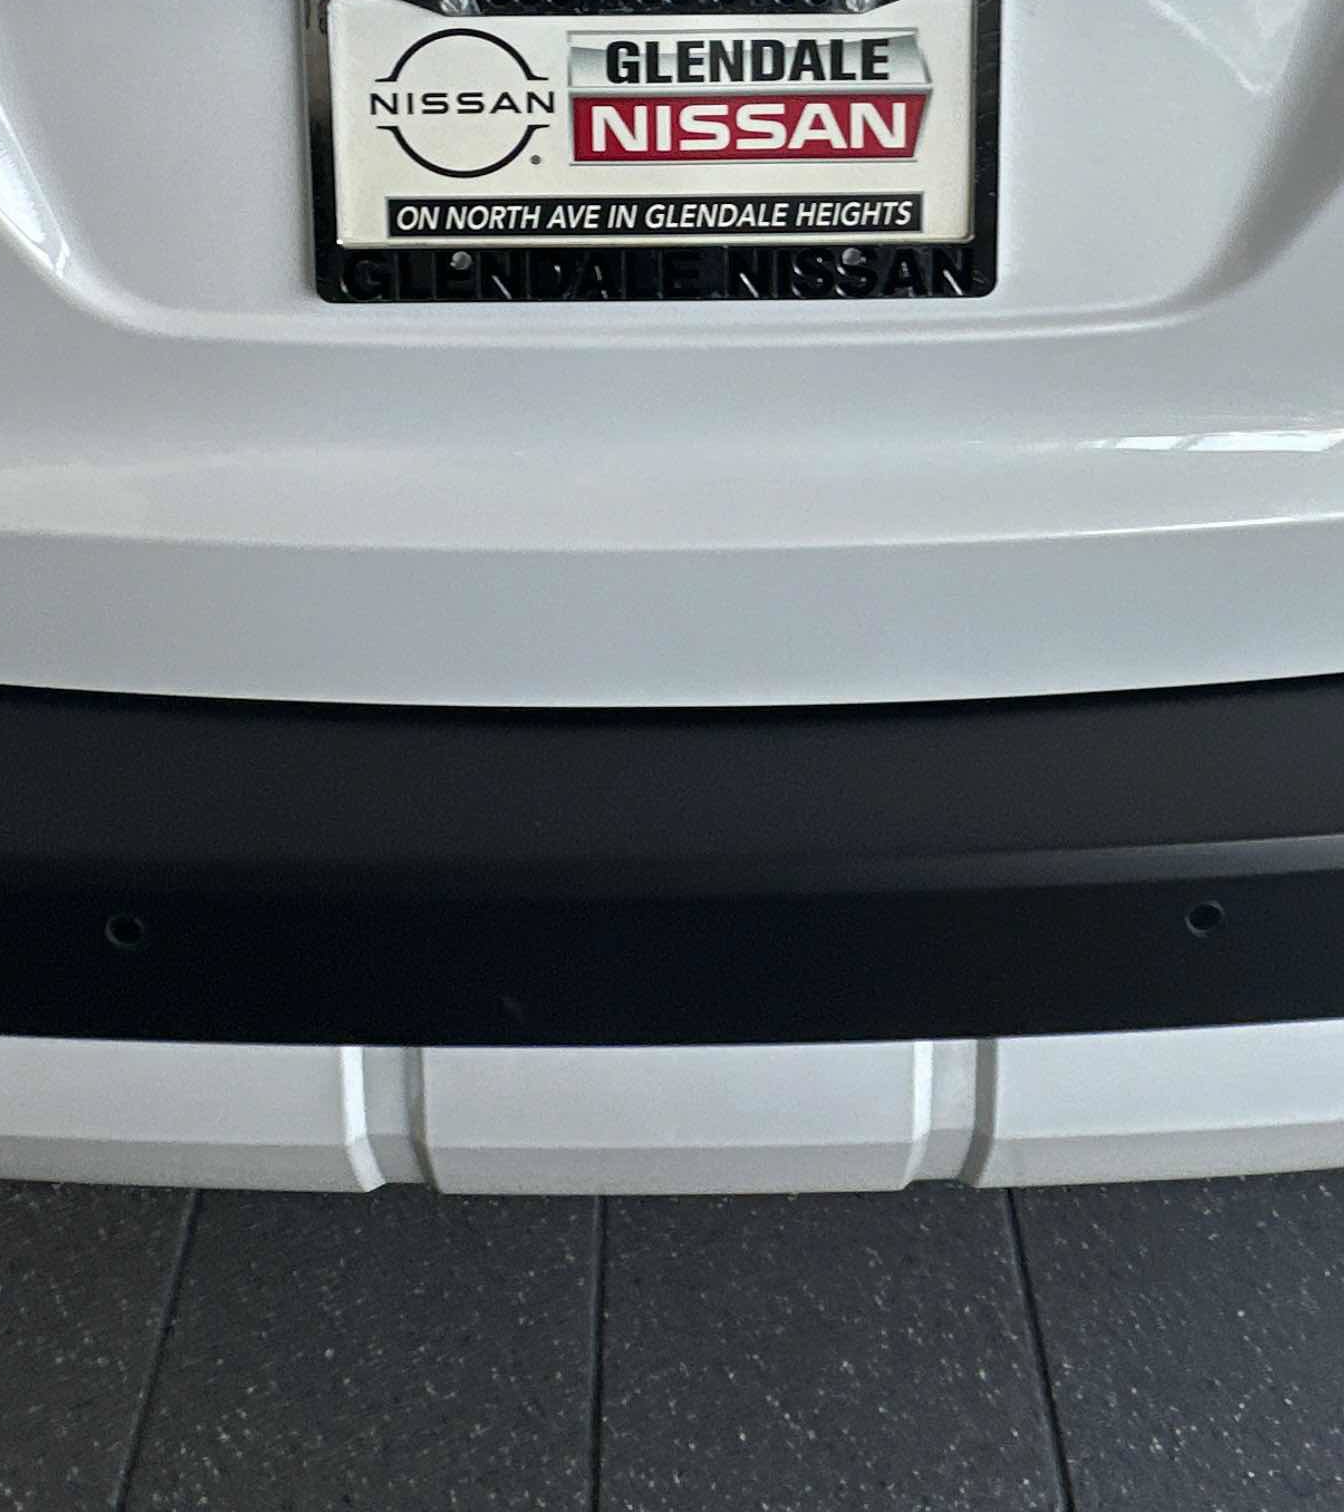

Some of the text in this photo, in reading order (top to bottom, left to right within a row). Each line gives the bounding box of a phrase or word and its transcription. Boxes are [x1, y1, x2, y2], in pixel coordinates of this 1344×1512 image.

[605, 39, 890, 84] GLENDALE
[370, 92, 555, 116] NISSAN
[591, 101, 907, 152] NISSAN
[396, 200, 913, 231] ON NORTH AVE IN GLENDALE HEIGHTS
[725, 245, 974, 298] NISSAN
